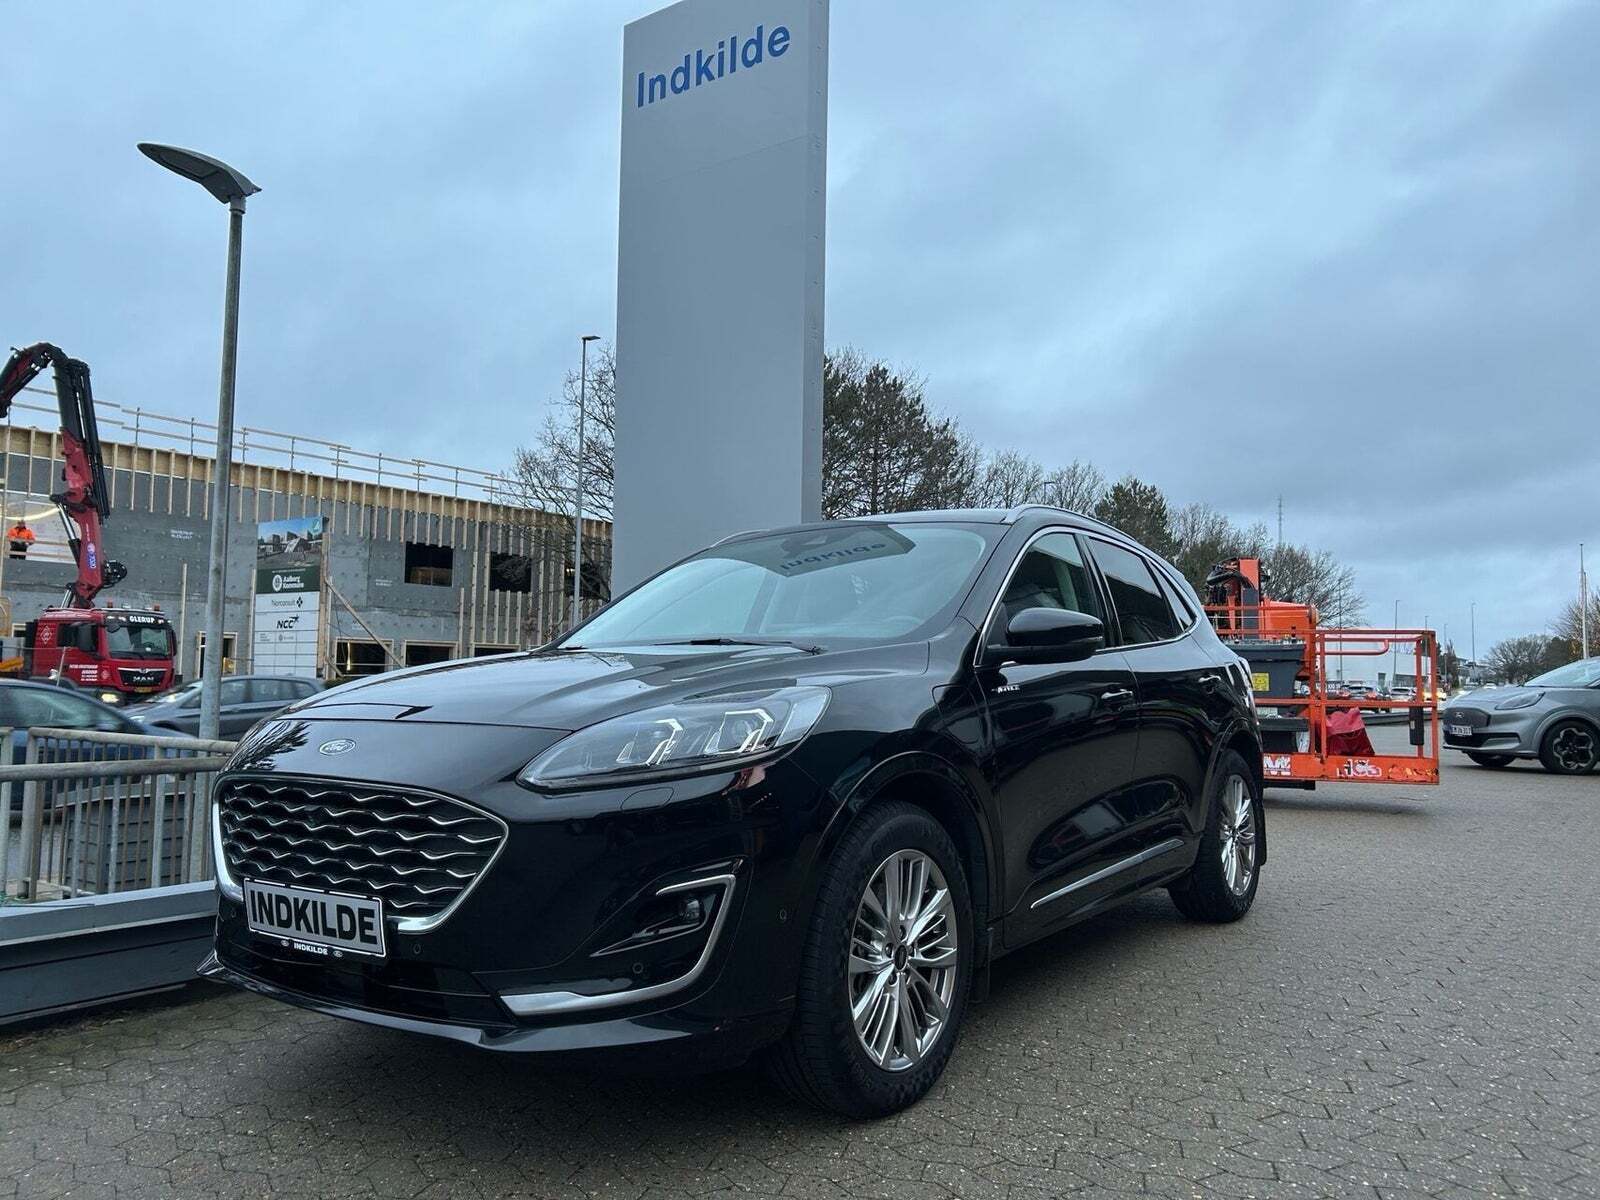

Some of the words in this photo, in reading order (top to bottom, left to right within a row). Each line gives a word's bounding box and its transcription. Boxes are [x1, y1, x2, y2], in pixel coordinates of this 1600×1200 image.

[637, 24, 791, 108] Indkilde
[129, 615, 155, 624] GLERUP
[276, 619, 295, 629] NCC
[249, 890, 378, 944] INDKILDE
[293, 943, 329, 955] INDKILDE
